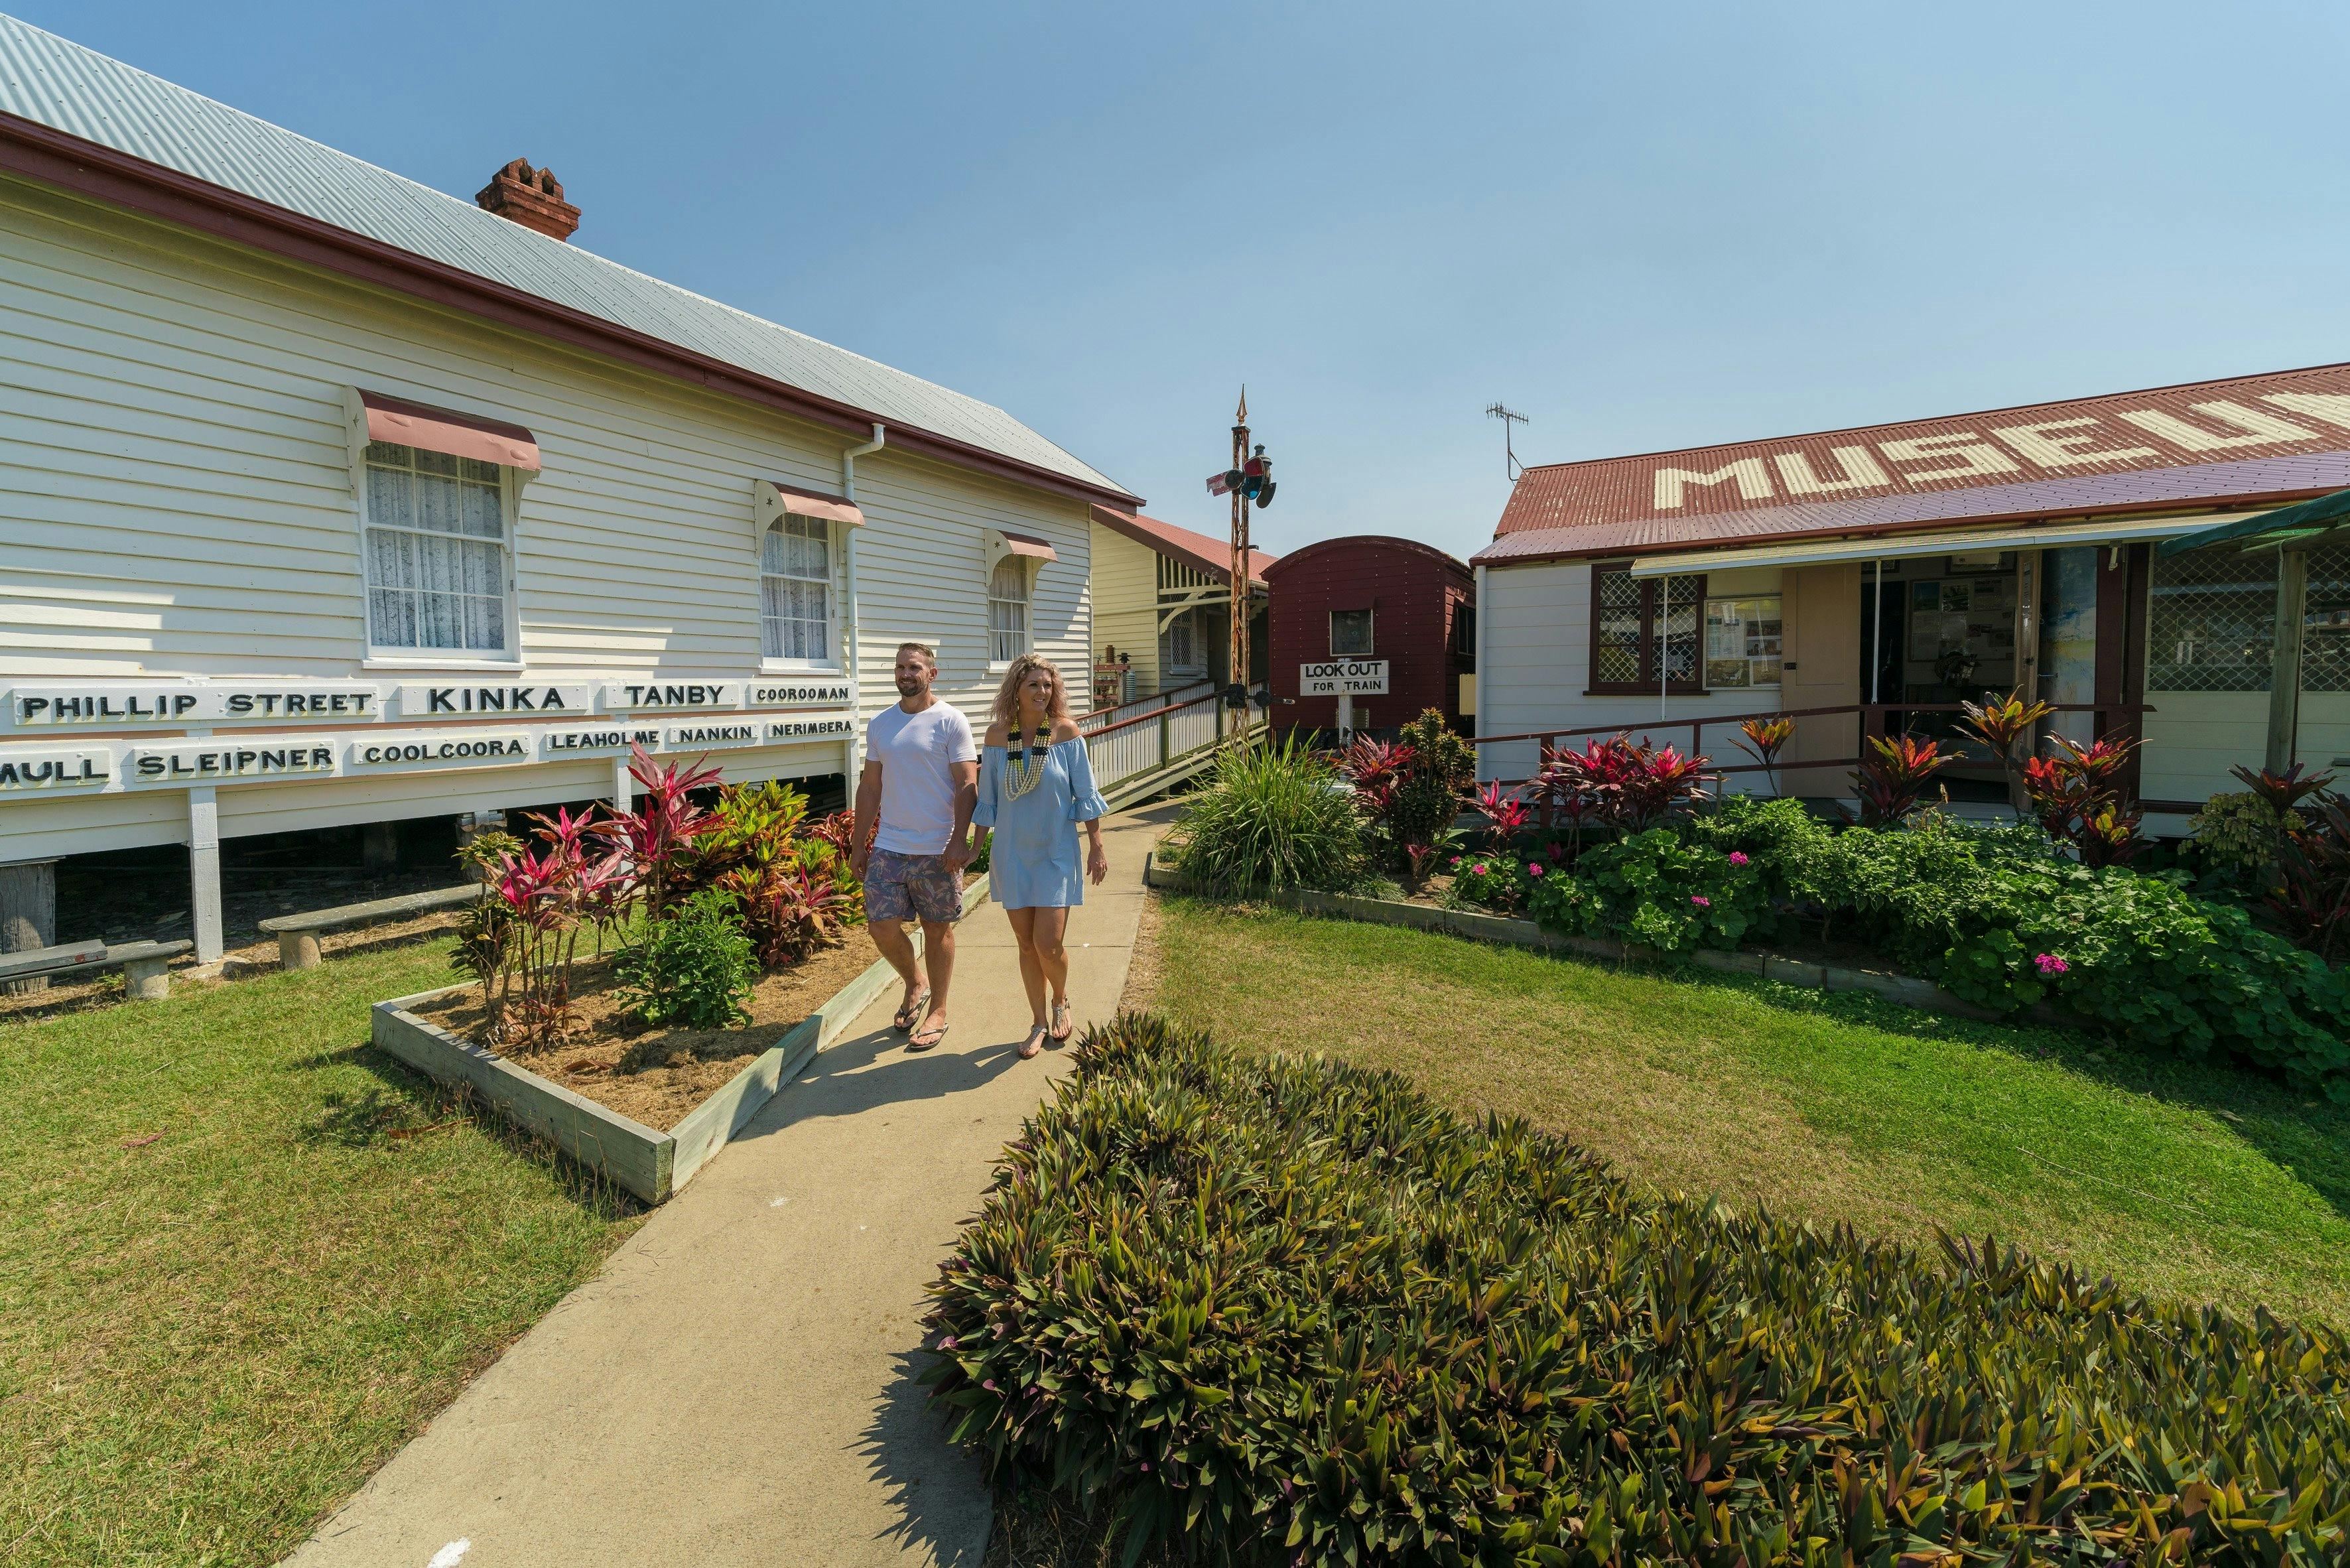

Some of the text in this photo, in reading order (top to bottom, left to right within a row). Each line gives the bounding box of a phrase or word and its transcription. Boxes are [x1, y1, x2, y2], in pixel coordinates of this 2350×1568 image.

[1305, 662, 1382, 678] LOOK OUT
[626, 686, 724, 704] TANBY
[757, 687, 849, 700] COOROOMAN
[1313, 681, 1382, 691] FOR TRAIN
[23, 694, 371, 718] PHILLIP STREET
[430, 688, 564, 711] KINKA
[681, 727, 751, 742] NANKIN
[773, 721, 851, 736] NERIMBERA
[551, 730, 659, 750] LEAHOLME
[365, 740, 524, 761] COOLCOORA
[138, 749, 332, 774] SLEIPNER
